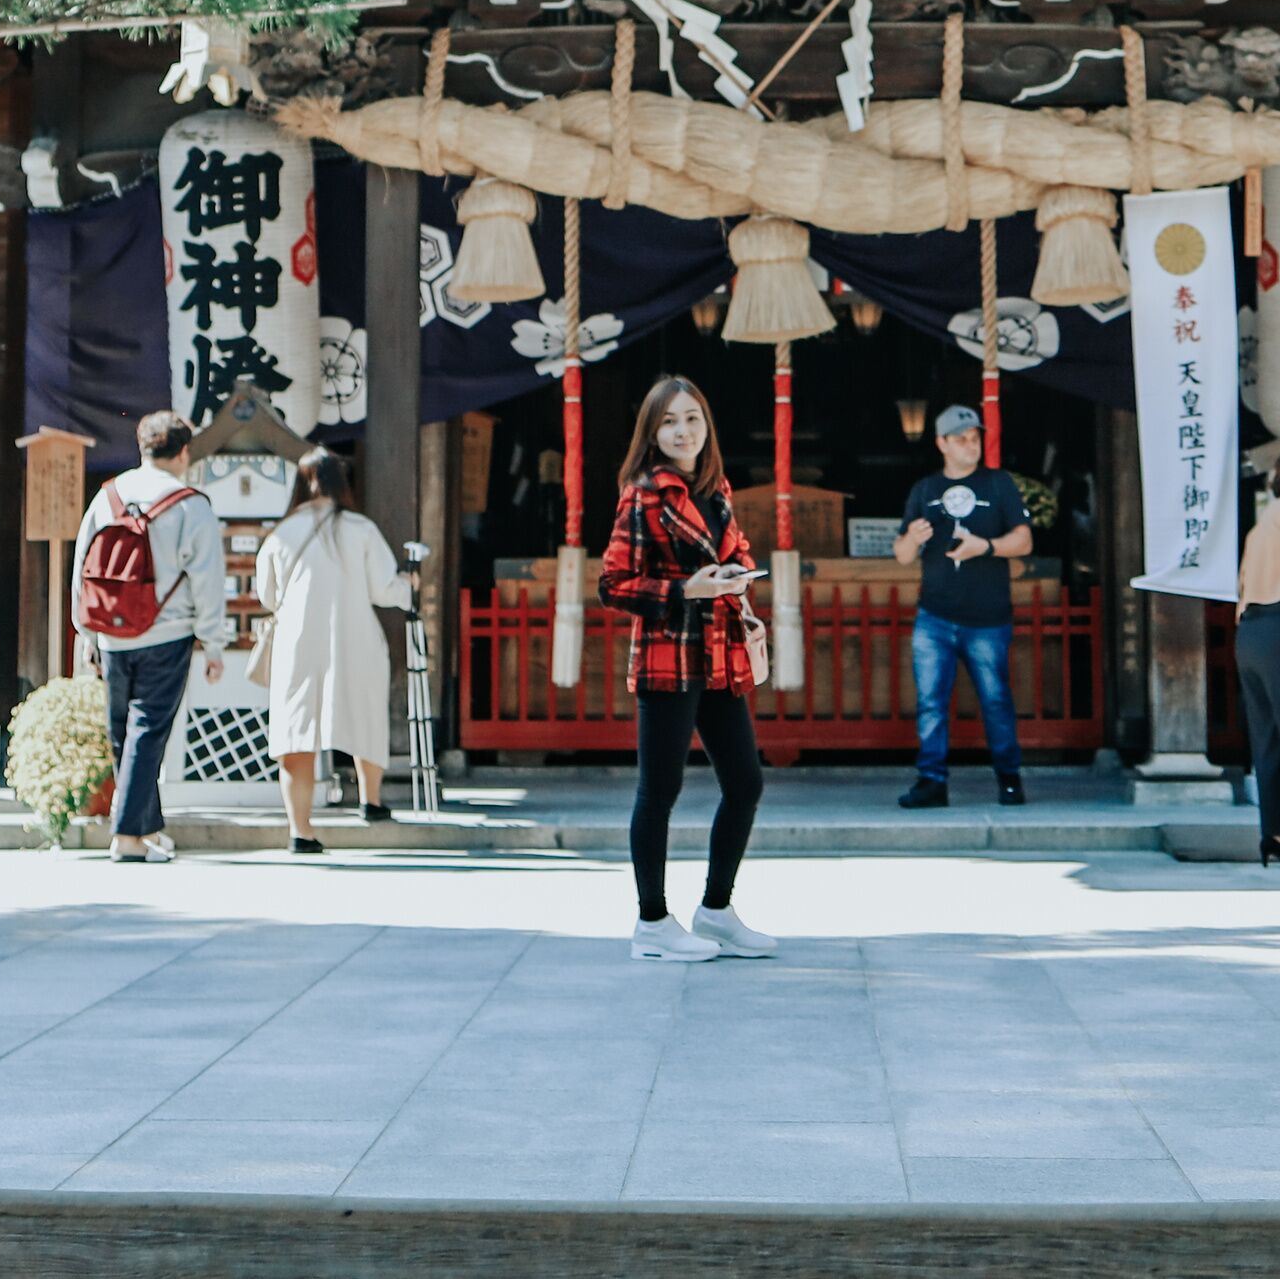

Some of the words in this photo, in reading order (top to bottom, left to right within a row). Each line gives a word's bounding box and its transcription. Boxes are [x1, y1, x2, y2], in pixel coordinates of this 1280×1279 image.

[1172, 284, 1201, 345] 奉祝
[1177, 360, 1210, 570] 天皇陛下御即位
